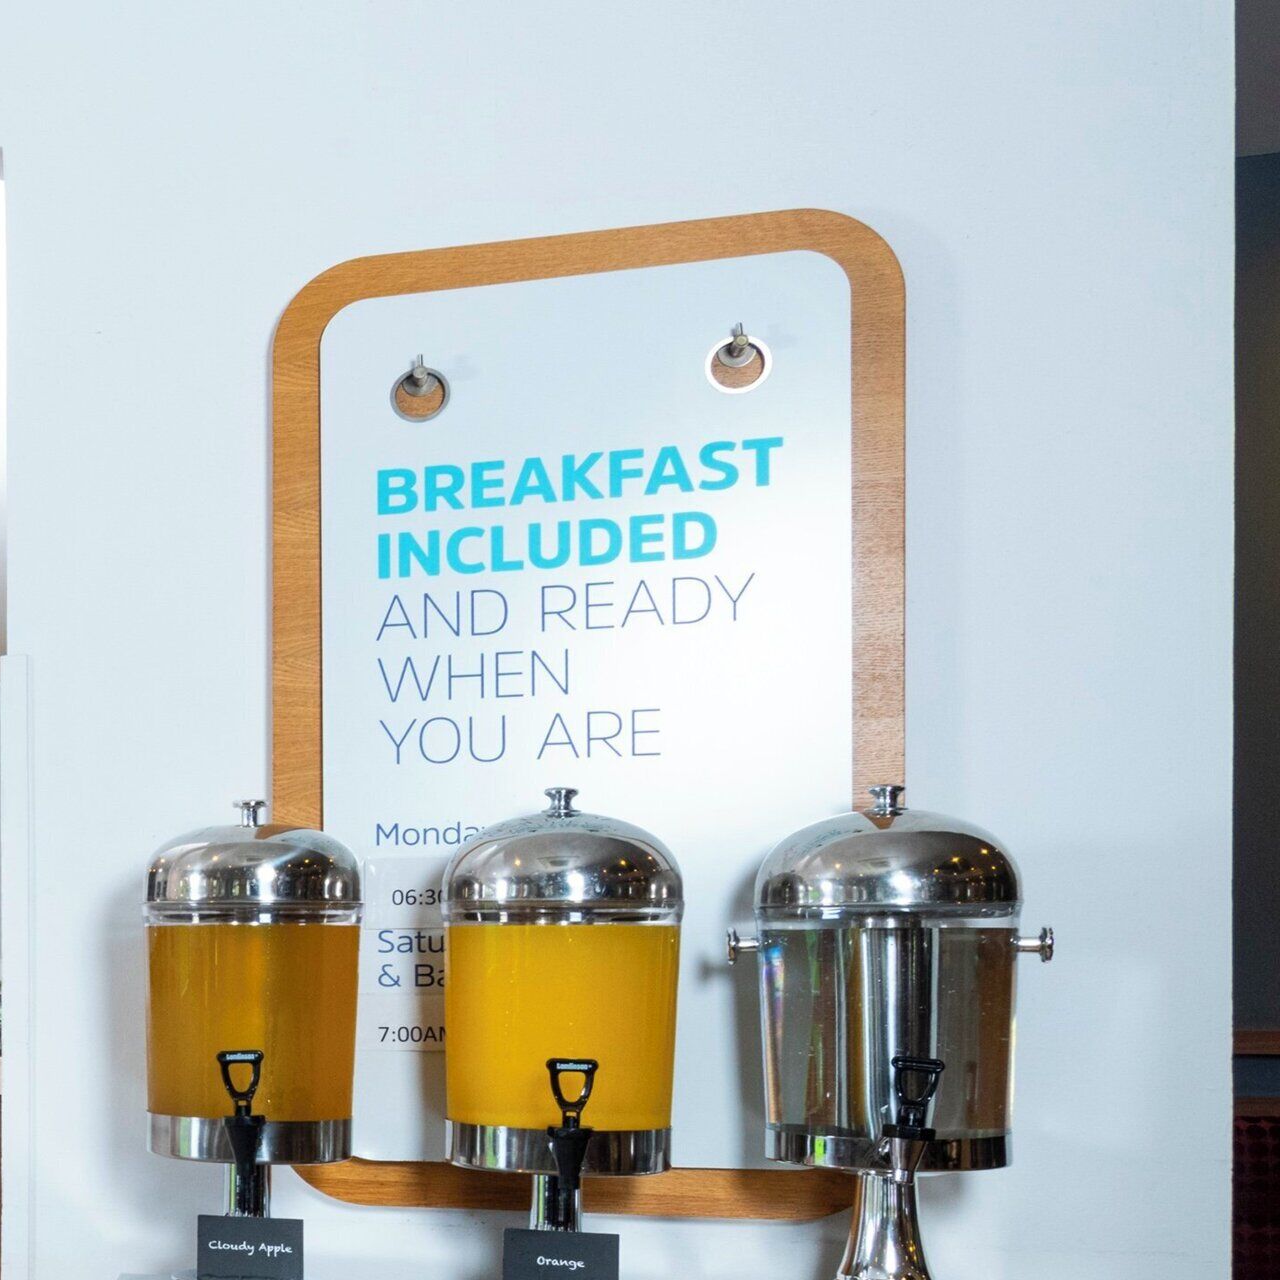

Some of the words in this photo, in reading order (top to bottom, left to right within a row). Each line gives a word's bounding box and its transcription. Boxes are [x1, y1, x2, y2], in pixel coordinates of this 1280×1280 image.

[376, 436, 784, 516] BREAKFAST
[377, 511, 718, 579] INCLUDED
[375, 588, 509, 642] AND
[541, 572, 756, 633] READY
[377, 648, 570, 703] WHEN
[379, 714, 507, 765] YOU
[537, 708, 662, 761] ARE
[376, 821, 484, 847] Monda
[378, 963, 401, 988] &
[208, 1240, 255, 1256] Cloudy
[258, 1242, 293, 1257] Apple
[536, 1255, 585, 1271] Orange
